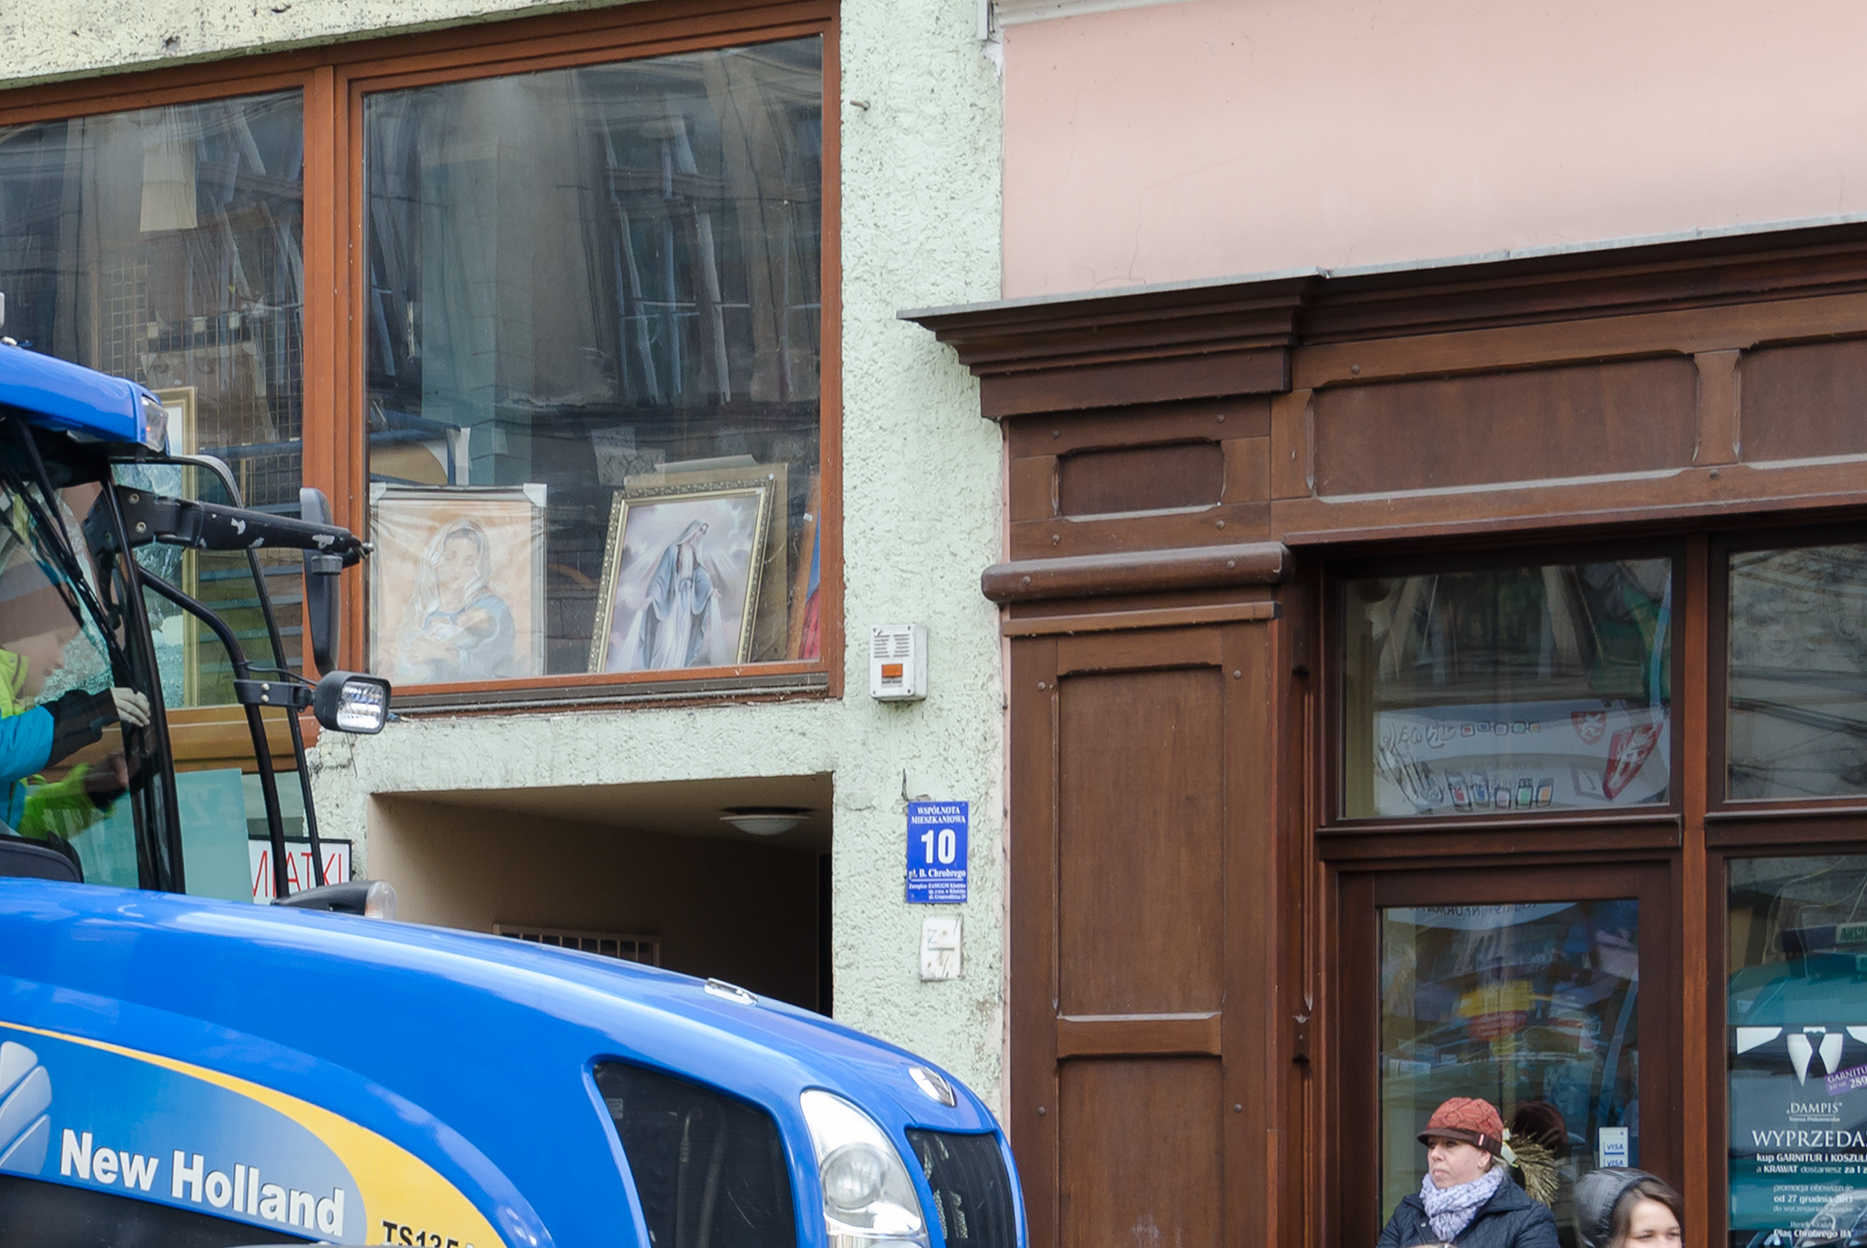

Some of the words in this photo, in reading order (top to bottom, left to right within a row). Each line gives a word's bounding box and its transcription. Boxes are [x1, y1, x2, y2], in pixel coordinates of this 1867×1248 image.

[911, 815, 966, 824] MIESZKANIOWA
[921, 828, 956, 864] 10
[928, 868, 966, 880] Chrobrego
[1751, 1130, 1867, 1147] WYPRZEDA
[1756, 1153, 1774, 1163] kup
[1776, 1153, 1823, 1162] GARNITUR
[1830, 1153, 1867, 1162] KOSZUL
[1763, 1165, 1798, 1173] KRAWAT
[1800, 1165, 1842, 1174] dostaniesz
[59, 1128, 159, 1192] New
[170, 1149, 346, 1237] Holland
[1773, 1194, 1785, 1203] od
[1787, 1194, 1798, 1203] 27
[1799, 1194, 1832, 1205] grudnia
[1793, 1229, 1838, 1239] Chrobrego
